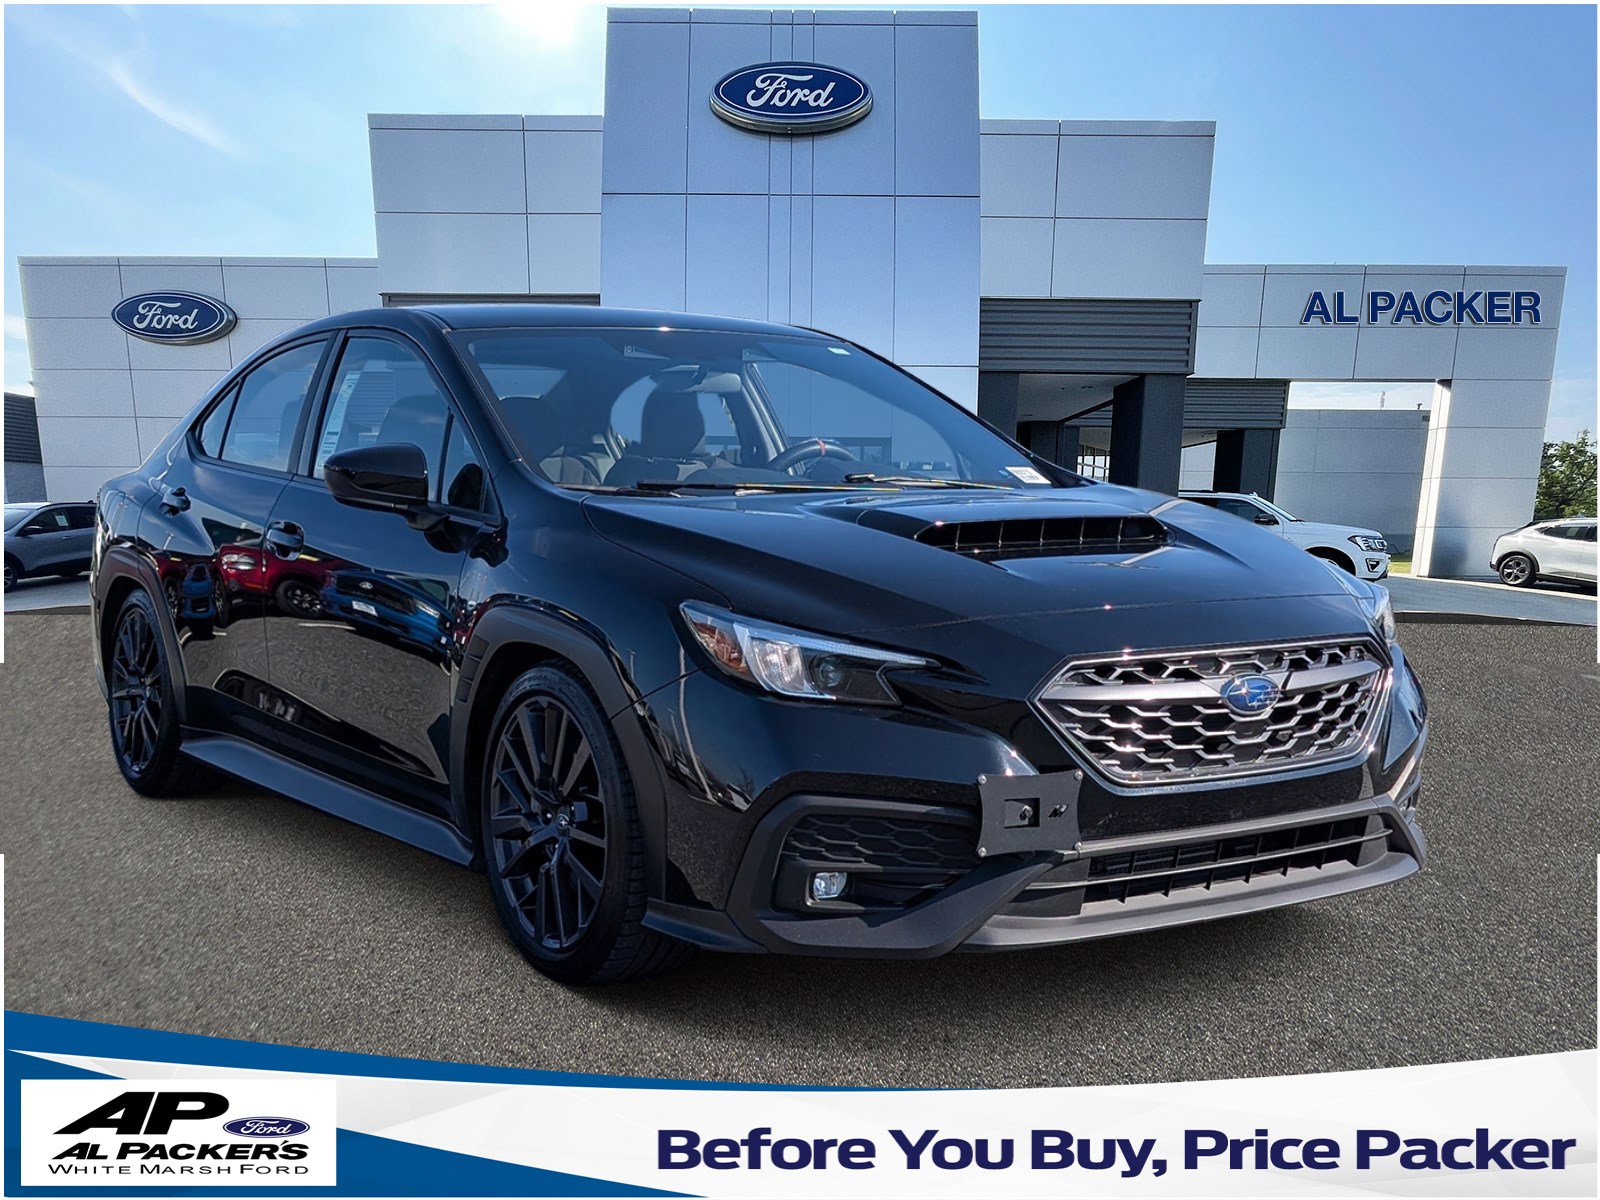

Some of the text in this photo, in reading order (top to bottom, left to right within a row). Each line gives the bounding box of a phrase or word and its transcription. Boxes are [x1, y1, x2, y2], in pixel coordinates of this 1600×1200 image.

[746, 73, 836, 107] Ford
[133, 300, 199, 330] Ford
[1301, 290, 1542, 325] AL PACKER
